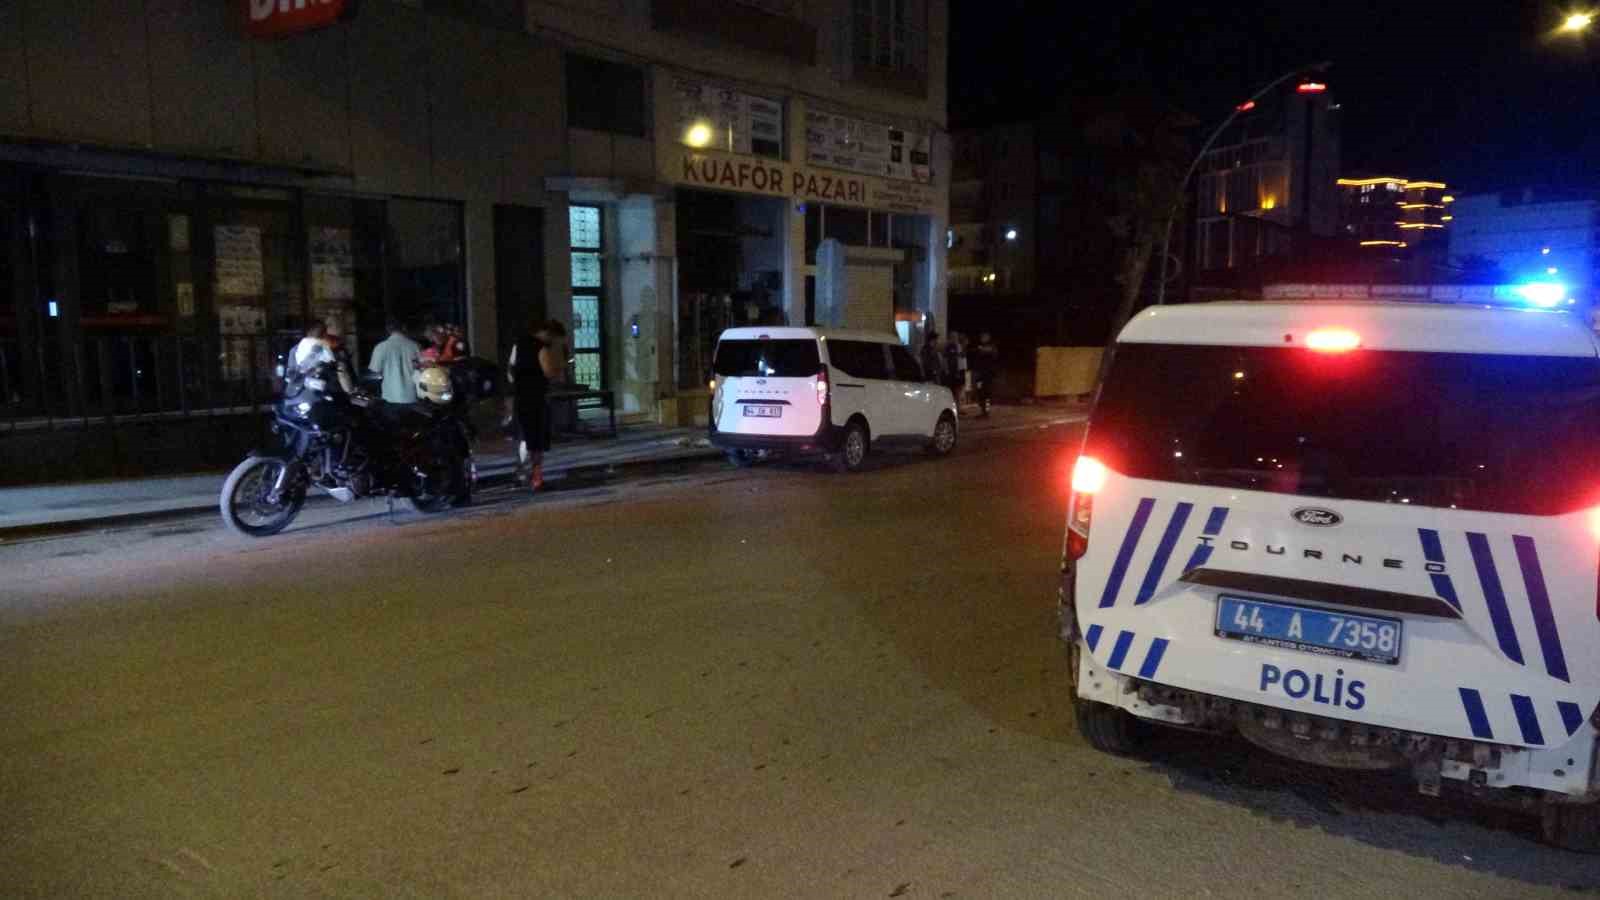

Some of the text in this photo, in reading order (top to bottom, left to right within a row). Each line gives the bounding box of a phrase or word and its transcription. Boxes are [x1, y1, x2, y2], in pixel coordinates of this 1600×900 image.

[683, 155, 784, 192] KUAFÖR
[1300, 509, 1333, 525] Ford
[1197, 536, 1446, 573] TOURNEO
[1233, 604, 1396, 652] 44 A 7358
[1259, 663, 1366, 710] POLİS
